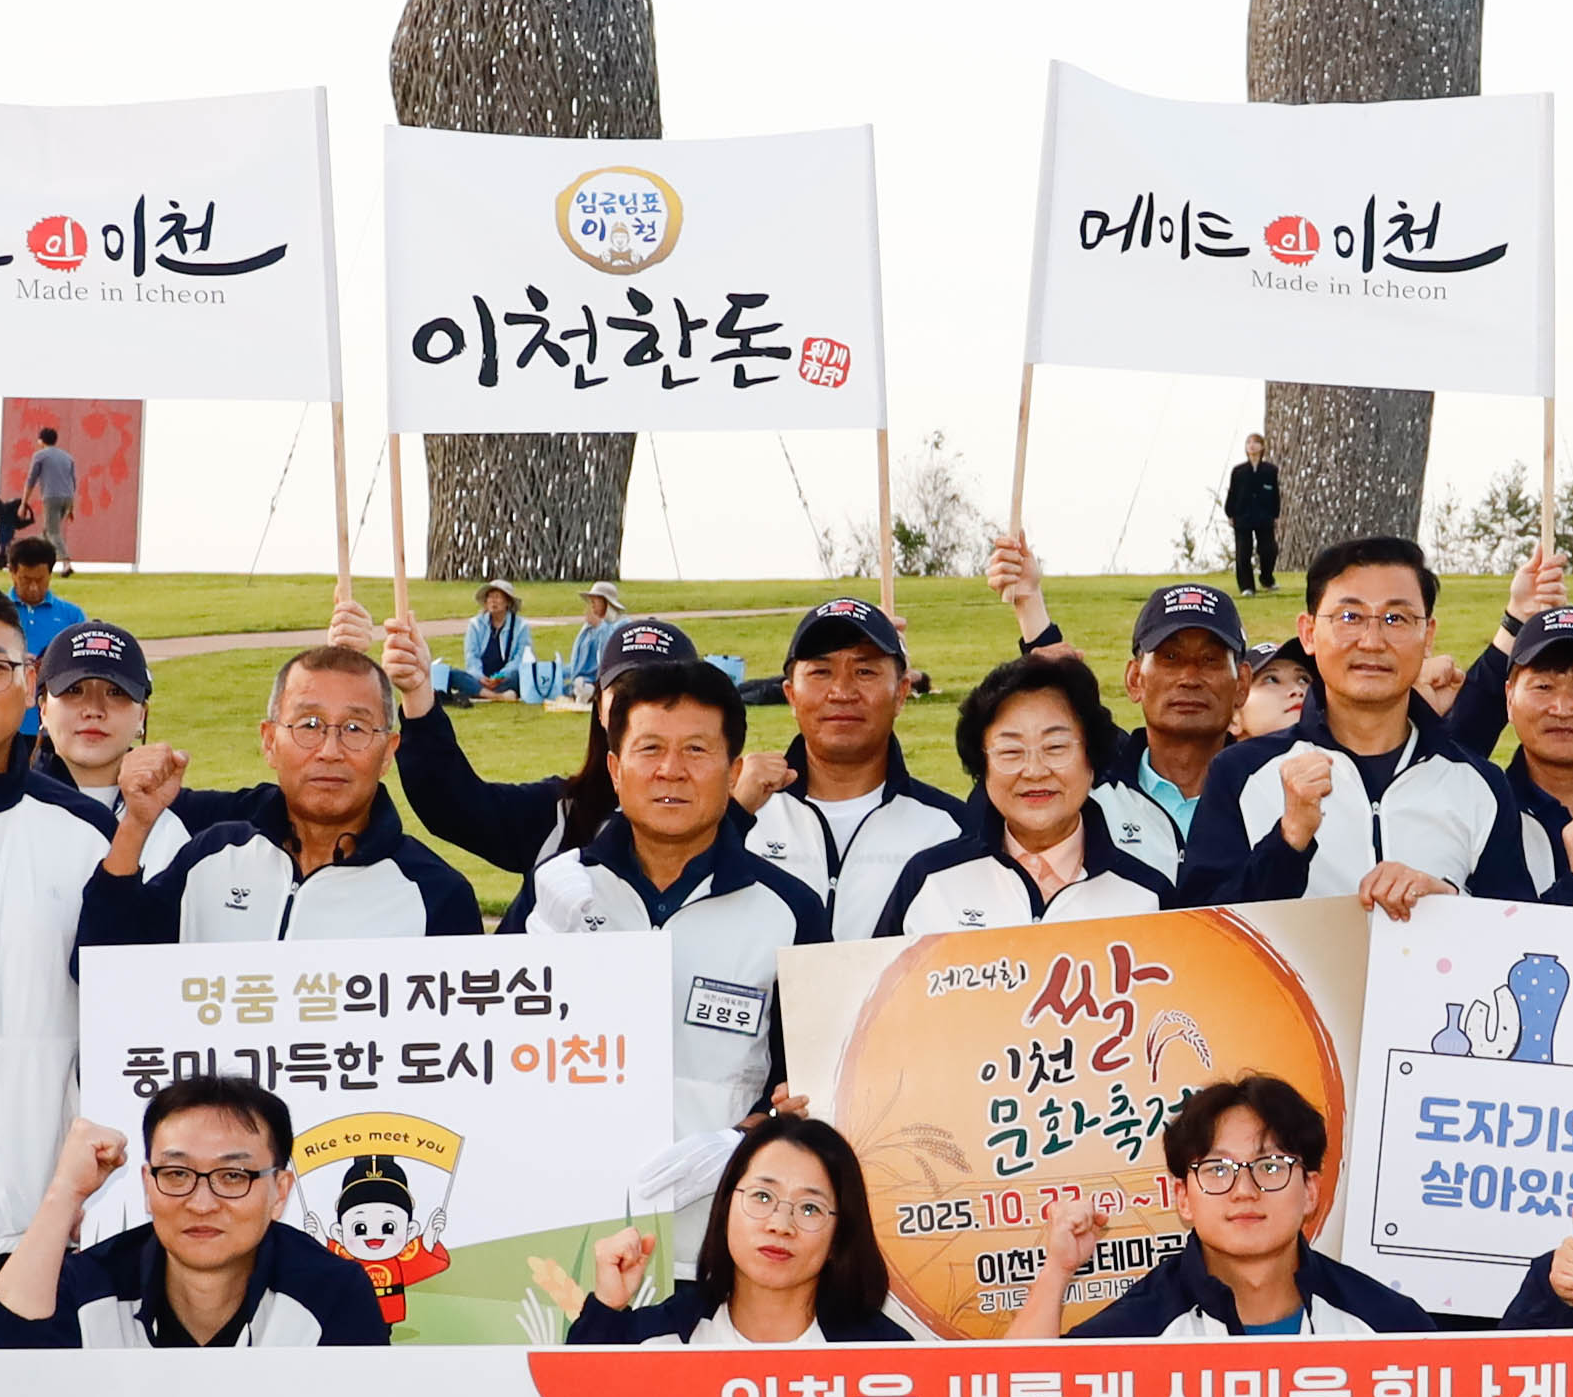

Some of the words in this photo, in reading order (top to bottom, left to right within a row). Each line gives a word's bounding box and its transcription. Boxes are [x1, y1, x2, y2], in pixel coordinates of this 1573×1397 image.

[576, 192, 662, 215] 임금님표
[32, 215, 87, 266] 인
[102, 194, 288, 277] 이천
[581, 217, 657, 243] 이천
[1080, 192, 1250, 259] 메이드
[1270, 216, 1319, 262] 인
[1333, 194, 1508, 273] 이천
[16, 279, 89, 301] Made
[101, 281, 124, 302] in
[135, 283, 226, 304] Icheon
[1251, 270, 1319, 293] Made
[1329, 277, 1352, 296] in
[1363, 279, 1448, 301] Icheon
[411, 284, 791, 390] 이천한돈
[182, 974, 278, 1024] 명품
[293, 971, 389, 1021] 쌀의
[407, 966, 569, 1021] 자부심,
[929, 960, 1026, 994] 제24회
[696, 1002, 751, 1027] 김영우
[1029, 945, 1169, 1072] 쌀
[234, 1041, 383, 1090] 가득한
[398, 1040, 492, 1084] 도시
[511, 1034, 625, 1083] 이천!
[981, 1038, 1074, 1093] 이천
[304, 1138, 337, 1158] Rice
[343, 1133, 362, 1144] to
[369, 1131, 410, 1143] meet
[416, 1137, 445, 1154] you
